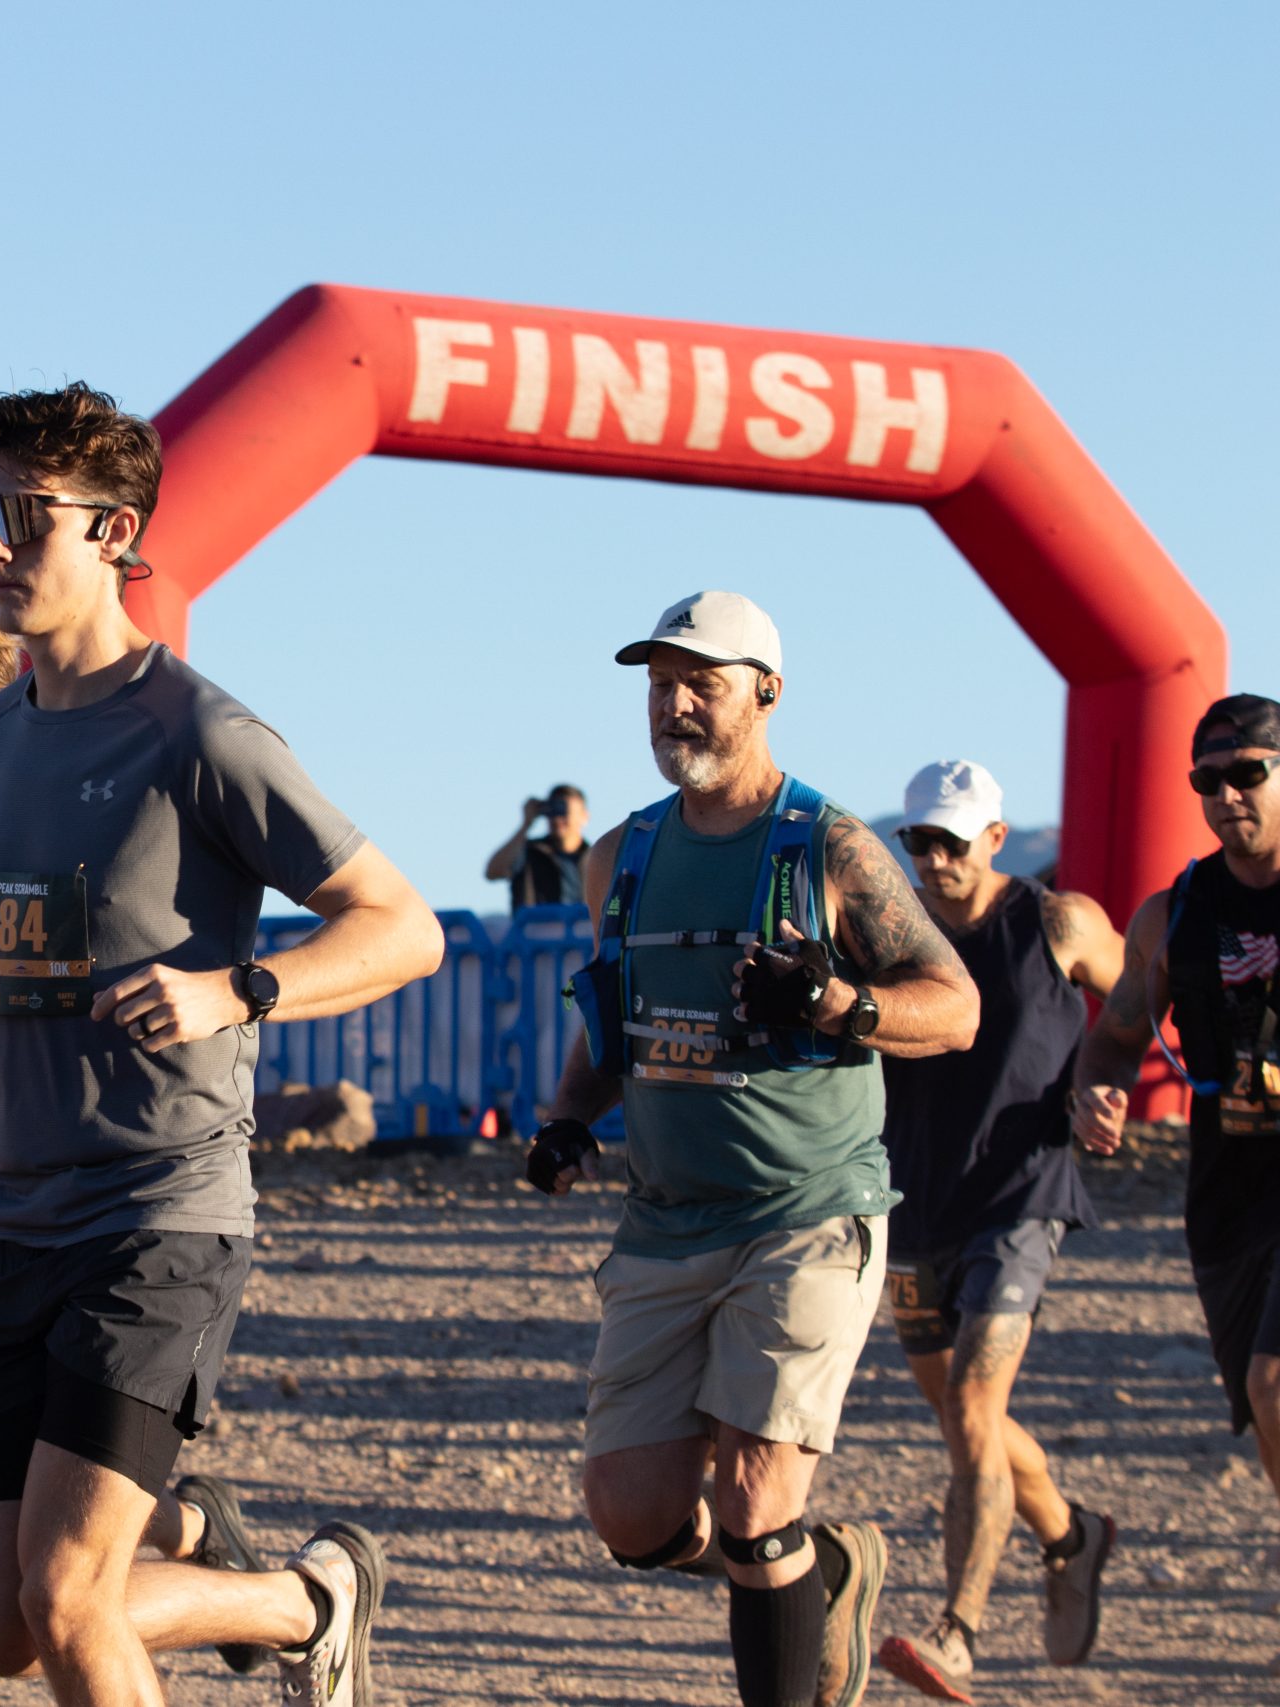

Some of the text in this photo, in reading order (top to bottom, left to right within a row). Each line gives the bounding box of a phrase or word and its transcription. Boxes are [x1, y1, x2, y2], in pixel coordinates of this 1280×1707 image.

[407, 316, 948, 474] FINISH
[14, 883, 49, 896] SCRAMBLE
[781, 862, 792, 918] AONIJIE
[49, 961, 70, 976] 10K
[651, 1008, 720, 1022] LIZARD PEAK SCRAMBLE
[649, 1019, 716, 1065] 205
